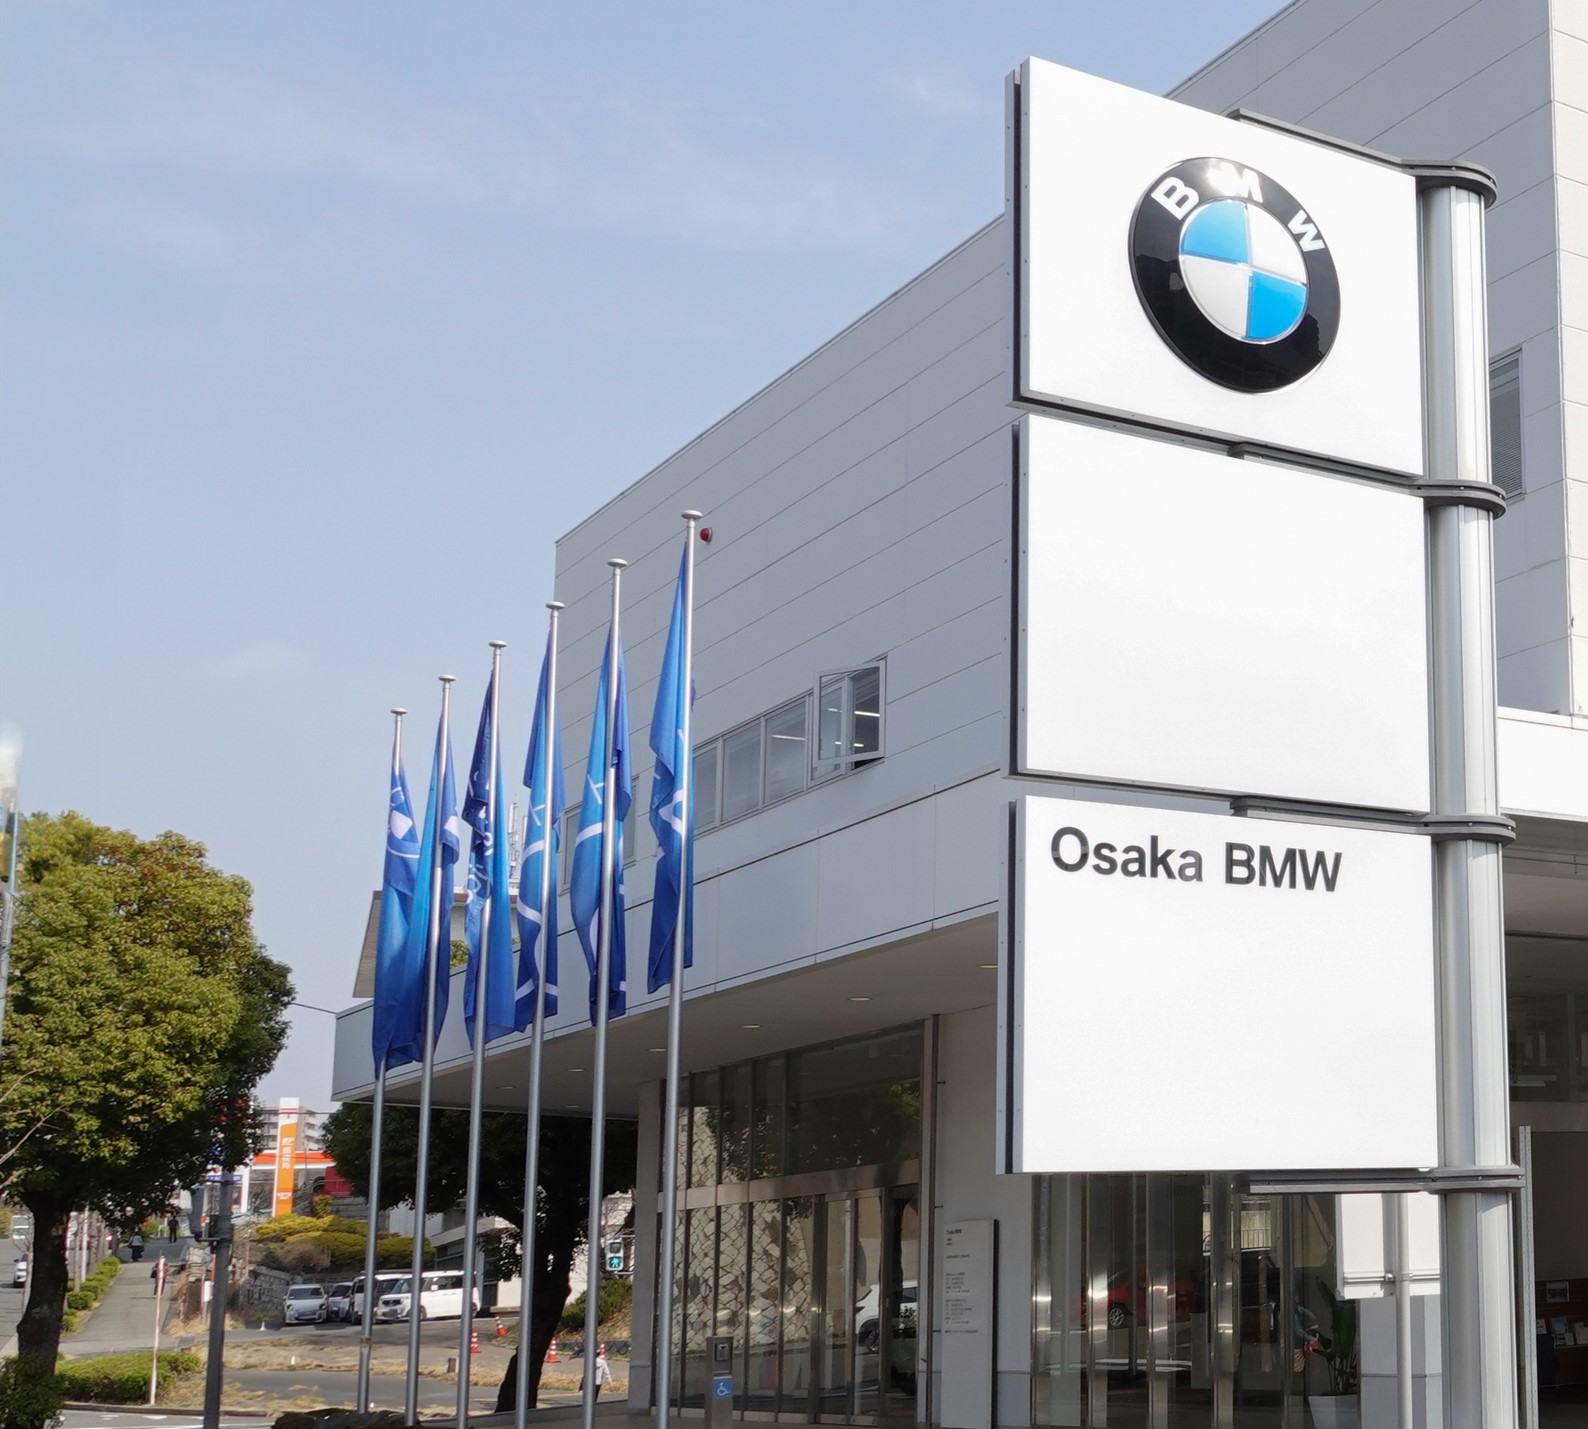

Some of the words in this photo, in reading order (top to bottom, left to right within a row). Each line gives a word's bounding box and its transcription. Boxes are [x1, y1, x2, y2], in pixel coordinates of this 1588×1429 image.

[1151, 162, 1327, 253] BMW
[1051, 826, 1203, 882] Osaka
[1225, 841, 1342, 892] BMW
